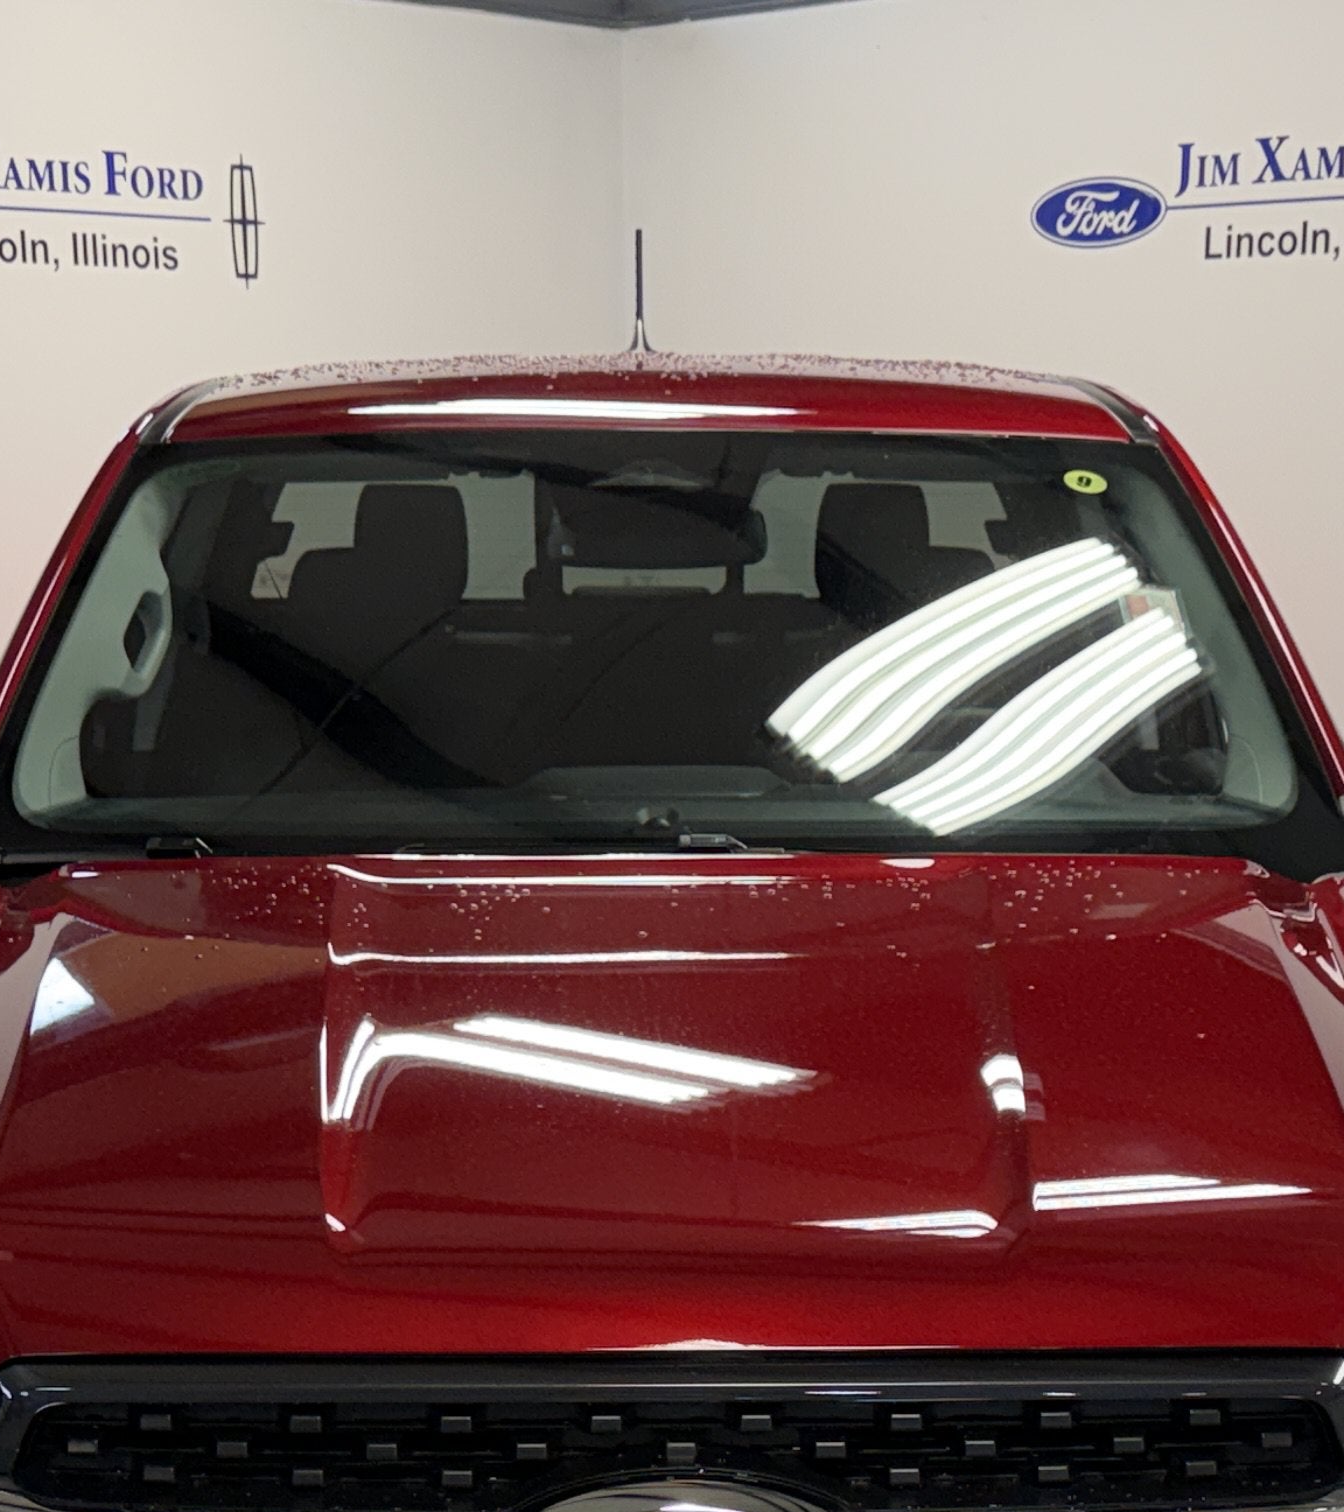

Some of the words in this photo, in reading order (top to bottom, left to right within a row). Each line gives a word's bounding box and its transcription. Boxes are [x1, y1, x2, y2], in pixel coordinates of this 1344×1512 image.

[103, 151, 202, 199] FORD
[1176, 144, 1239, 197] JIM
[1056, 190, 1137, 236] Ford
[72, 233, 178, 270] Illinois
[1205, 221, 1339, 259] Lincoln,
